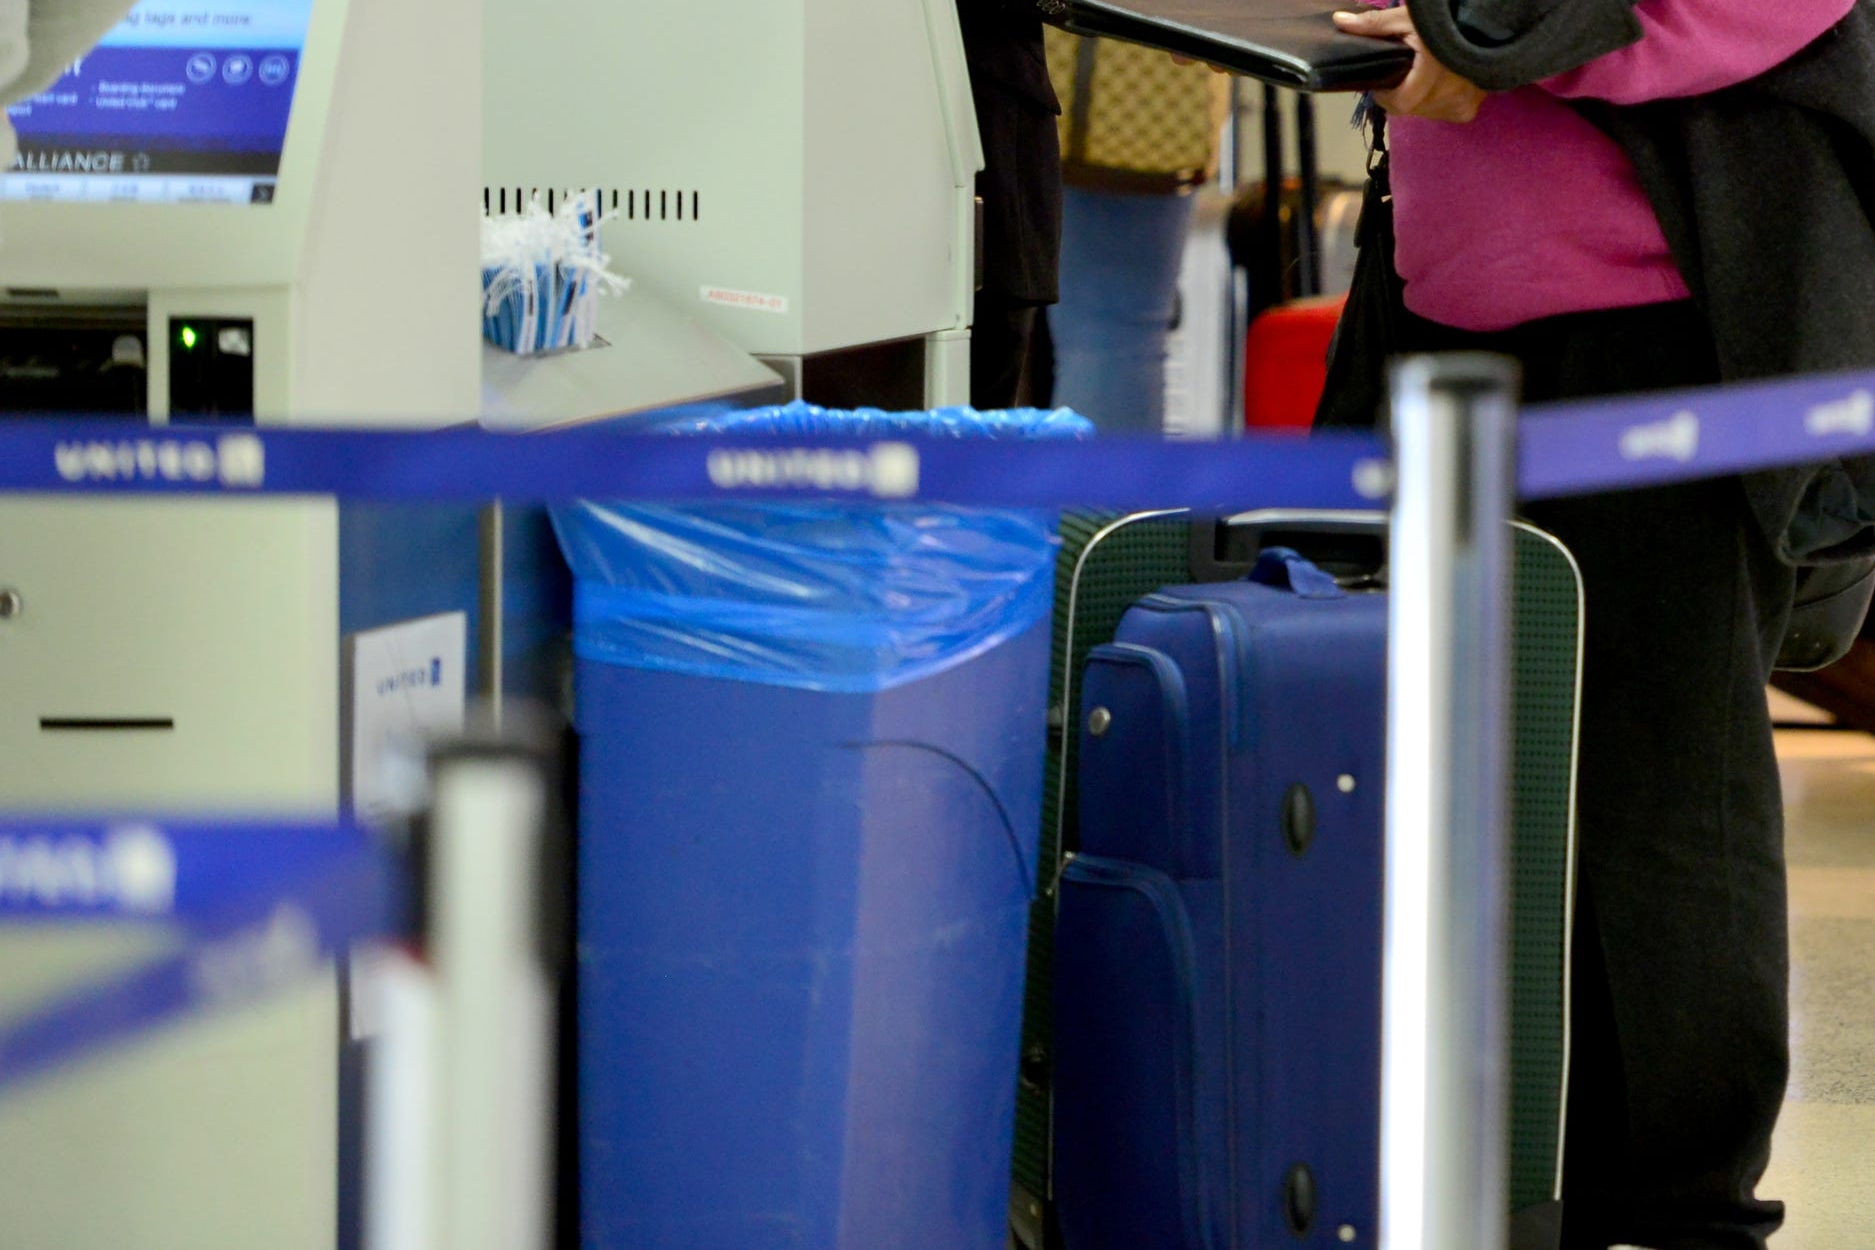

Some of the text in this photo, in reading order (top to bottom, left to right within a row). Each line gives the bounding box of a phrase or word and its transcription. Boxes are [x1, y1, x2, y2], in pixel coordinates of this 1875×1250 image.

[144, 8, 177, 27] tags
[180, 9, 208, 24] and
[212, 12, 252, 26] more
[13, 151, 125, 173] ALLIANCE
[54, 440, 215, 483] UNITED
[706, 448, 864, 489] UNITED
[376, 667, 426, 697] UNITED
